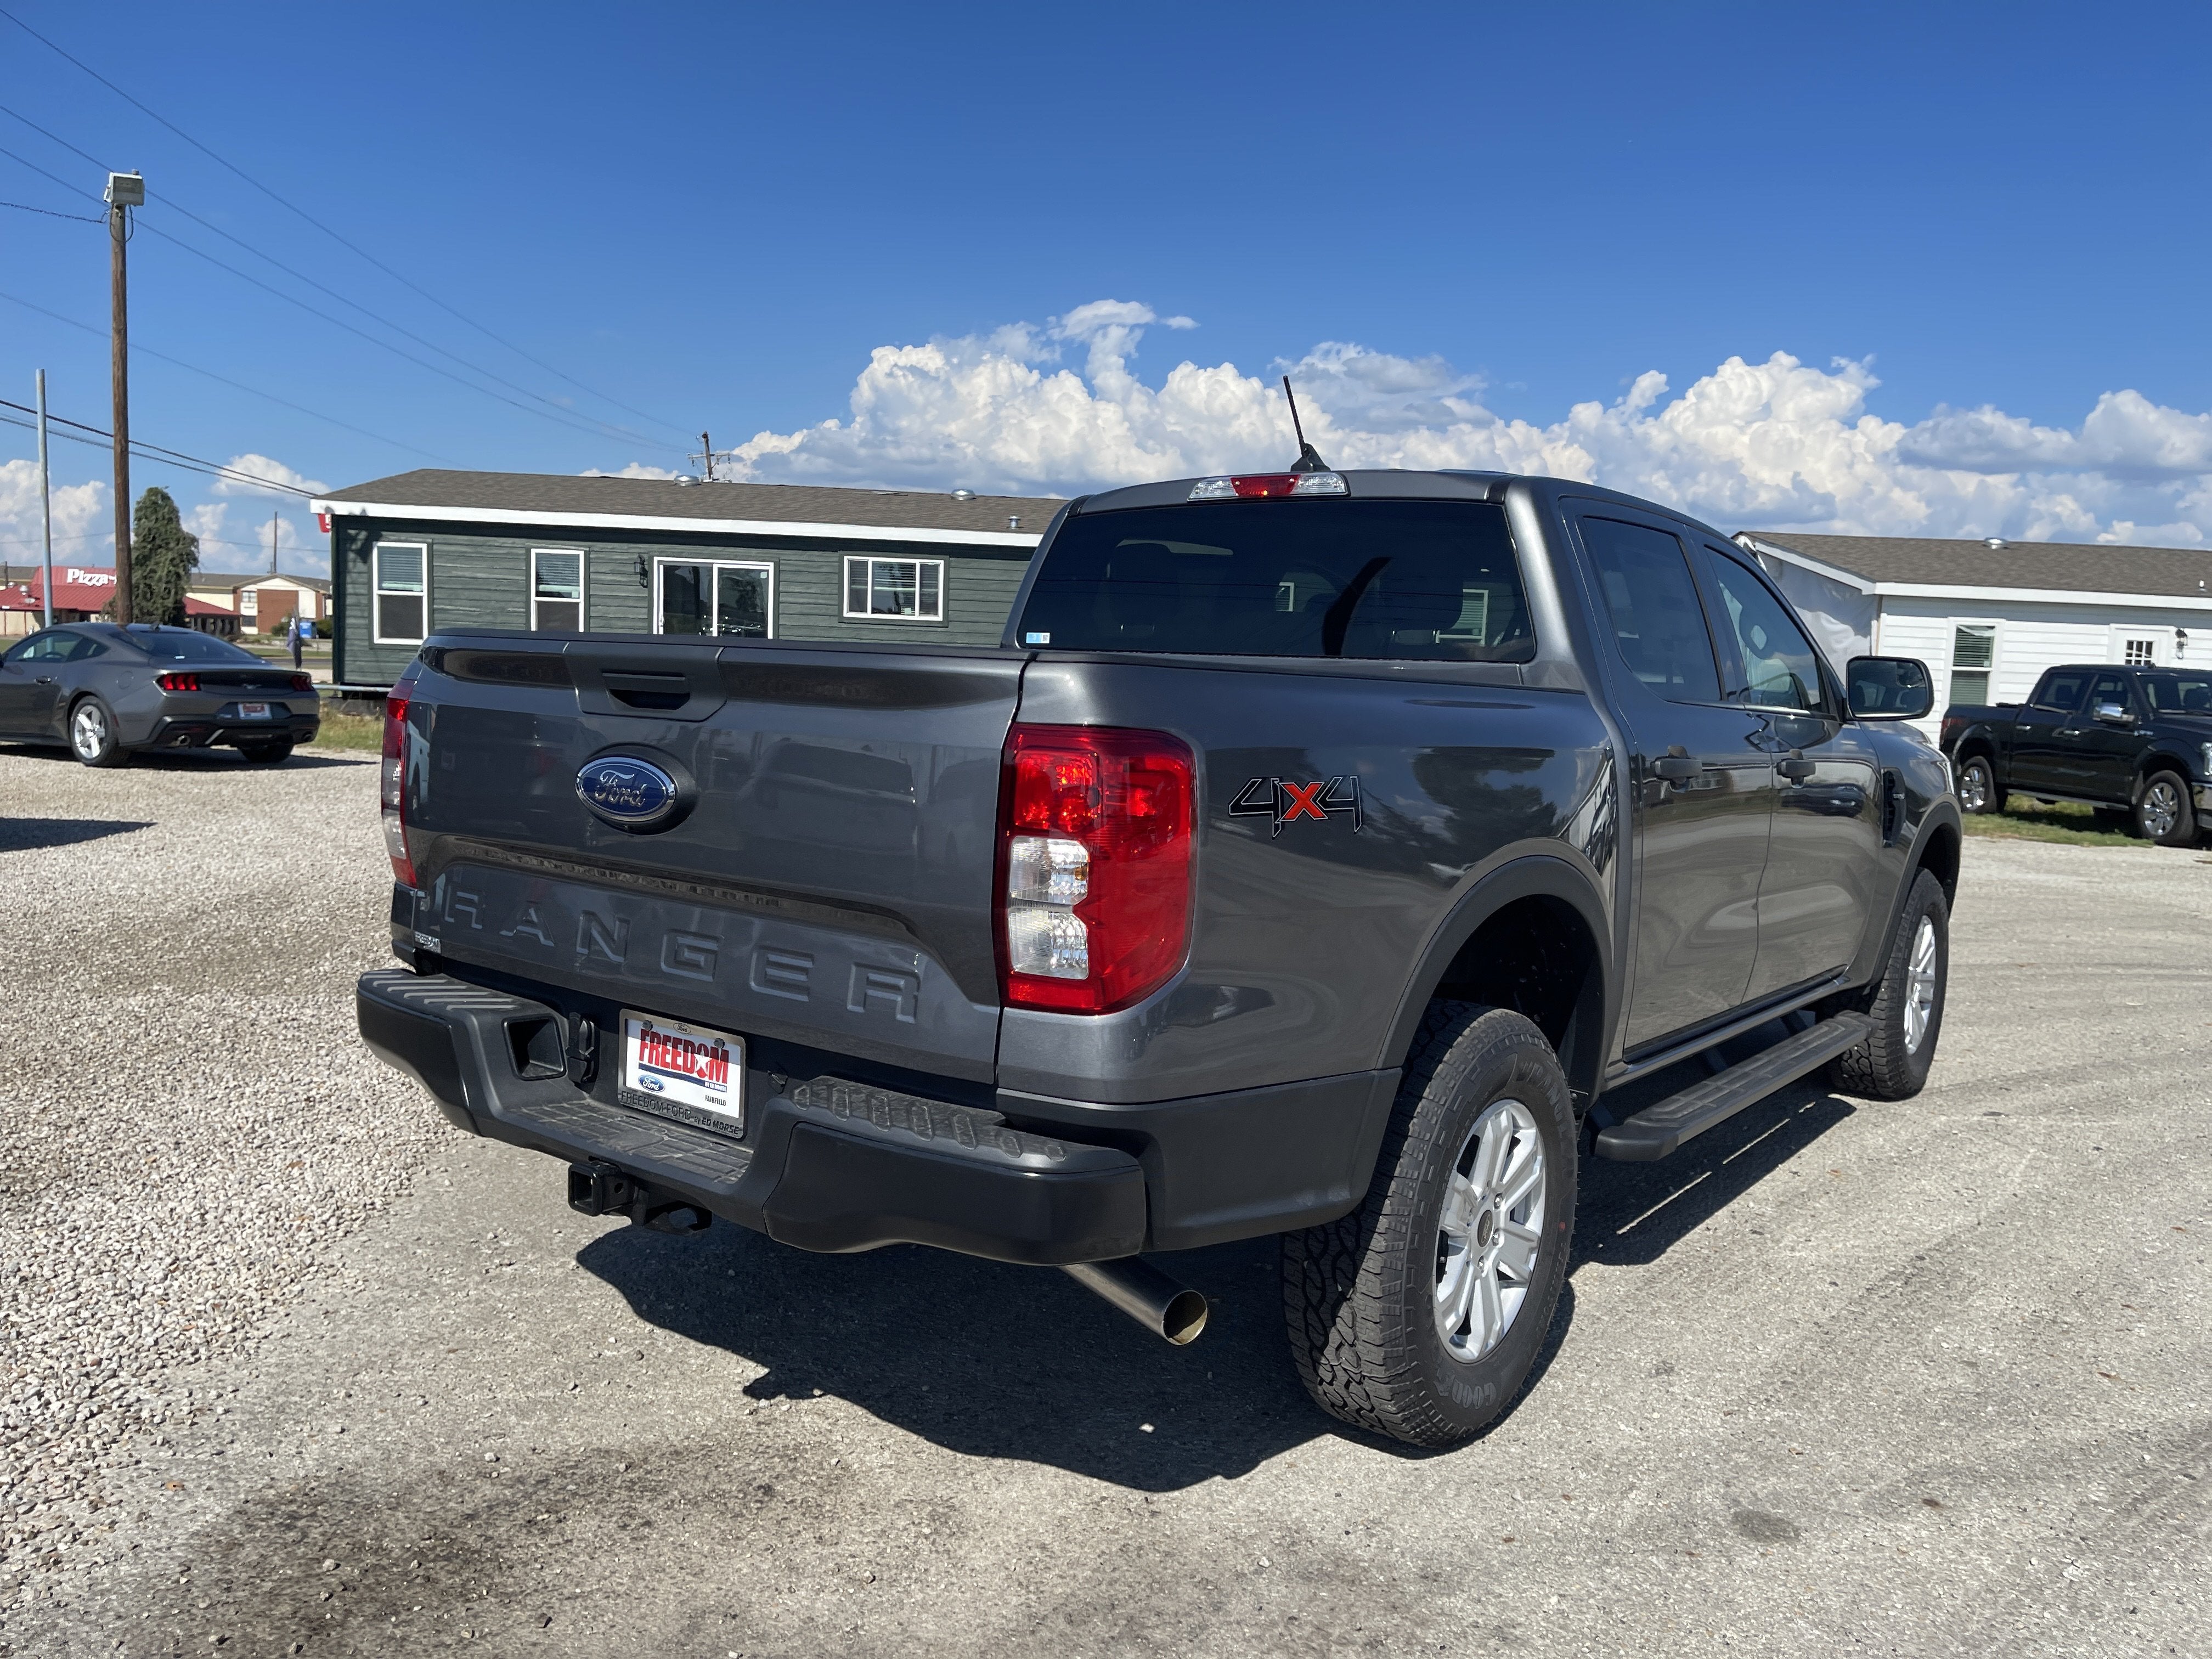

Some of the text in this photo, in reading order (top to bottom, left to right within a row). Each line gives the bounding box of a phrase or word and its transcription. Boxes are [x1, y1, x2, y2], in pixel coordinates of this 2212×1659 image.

[67, 568, 109, 586] Pizza
[595, 770, 648, 808] Ford
[443, 885, 921, 1024] RANGER
[639, 1028, 729, 1085] FREEDOM
[702, 1117, 712, 1126] ED
